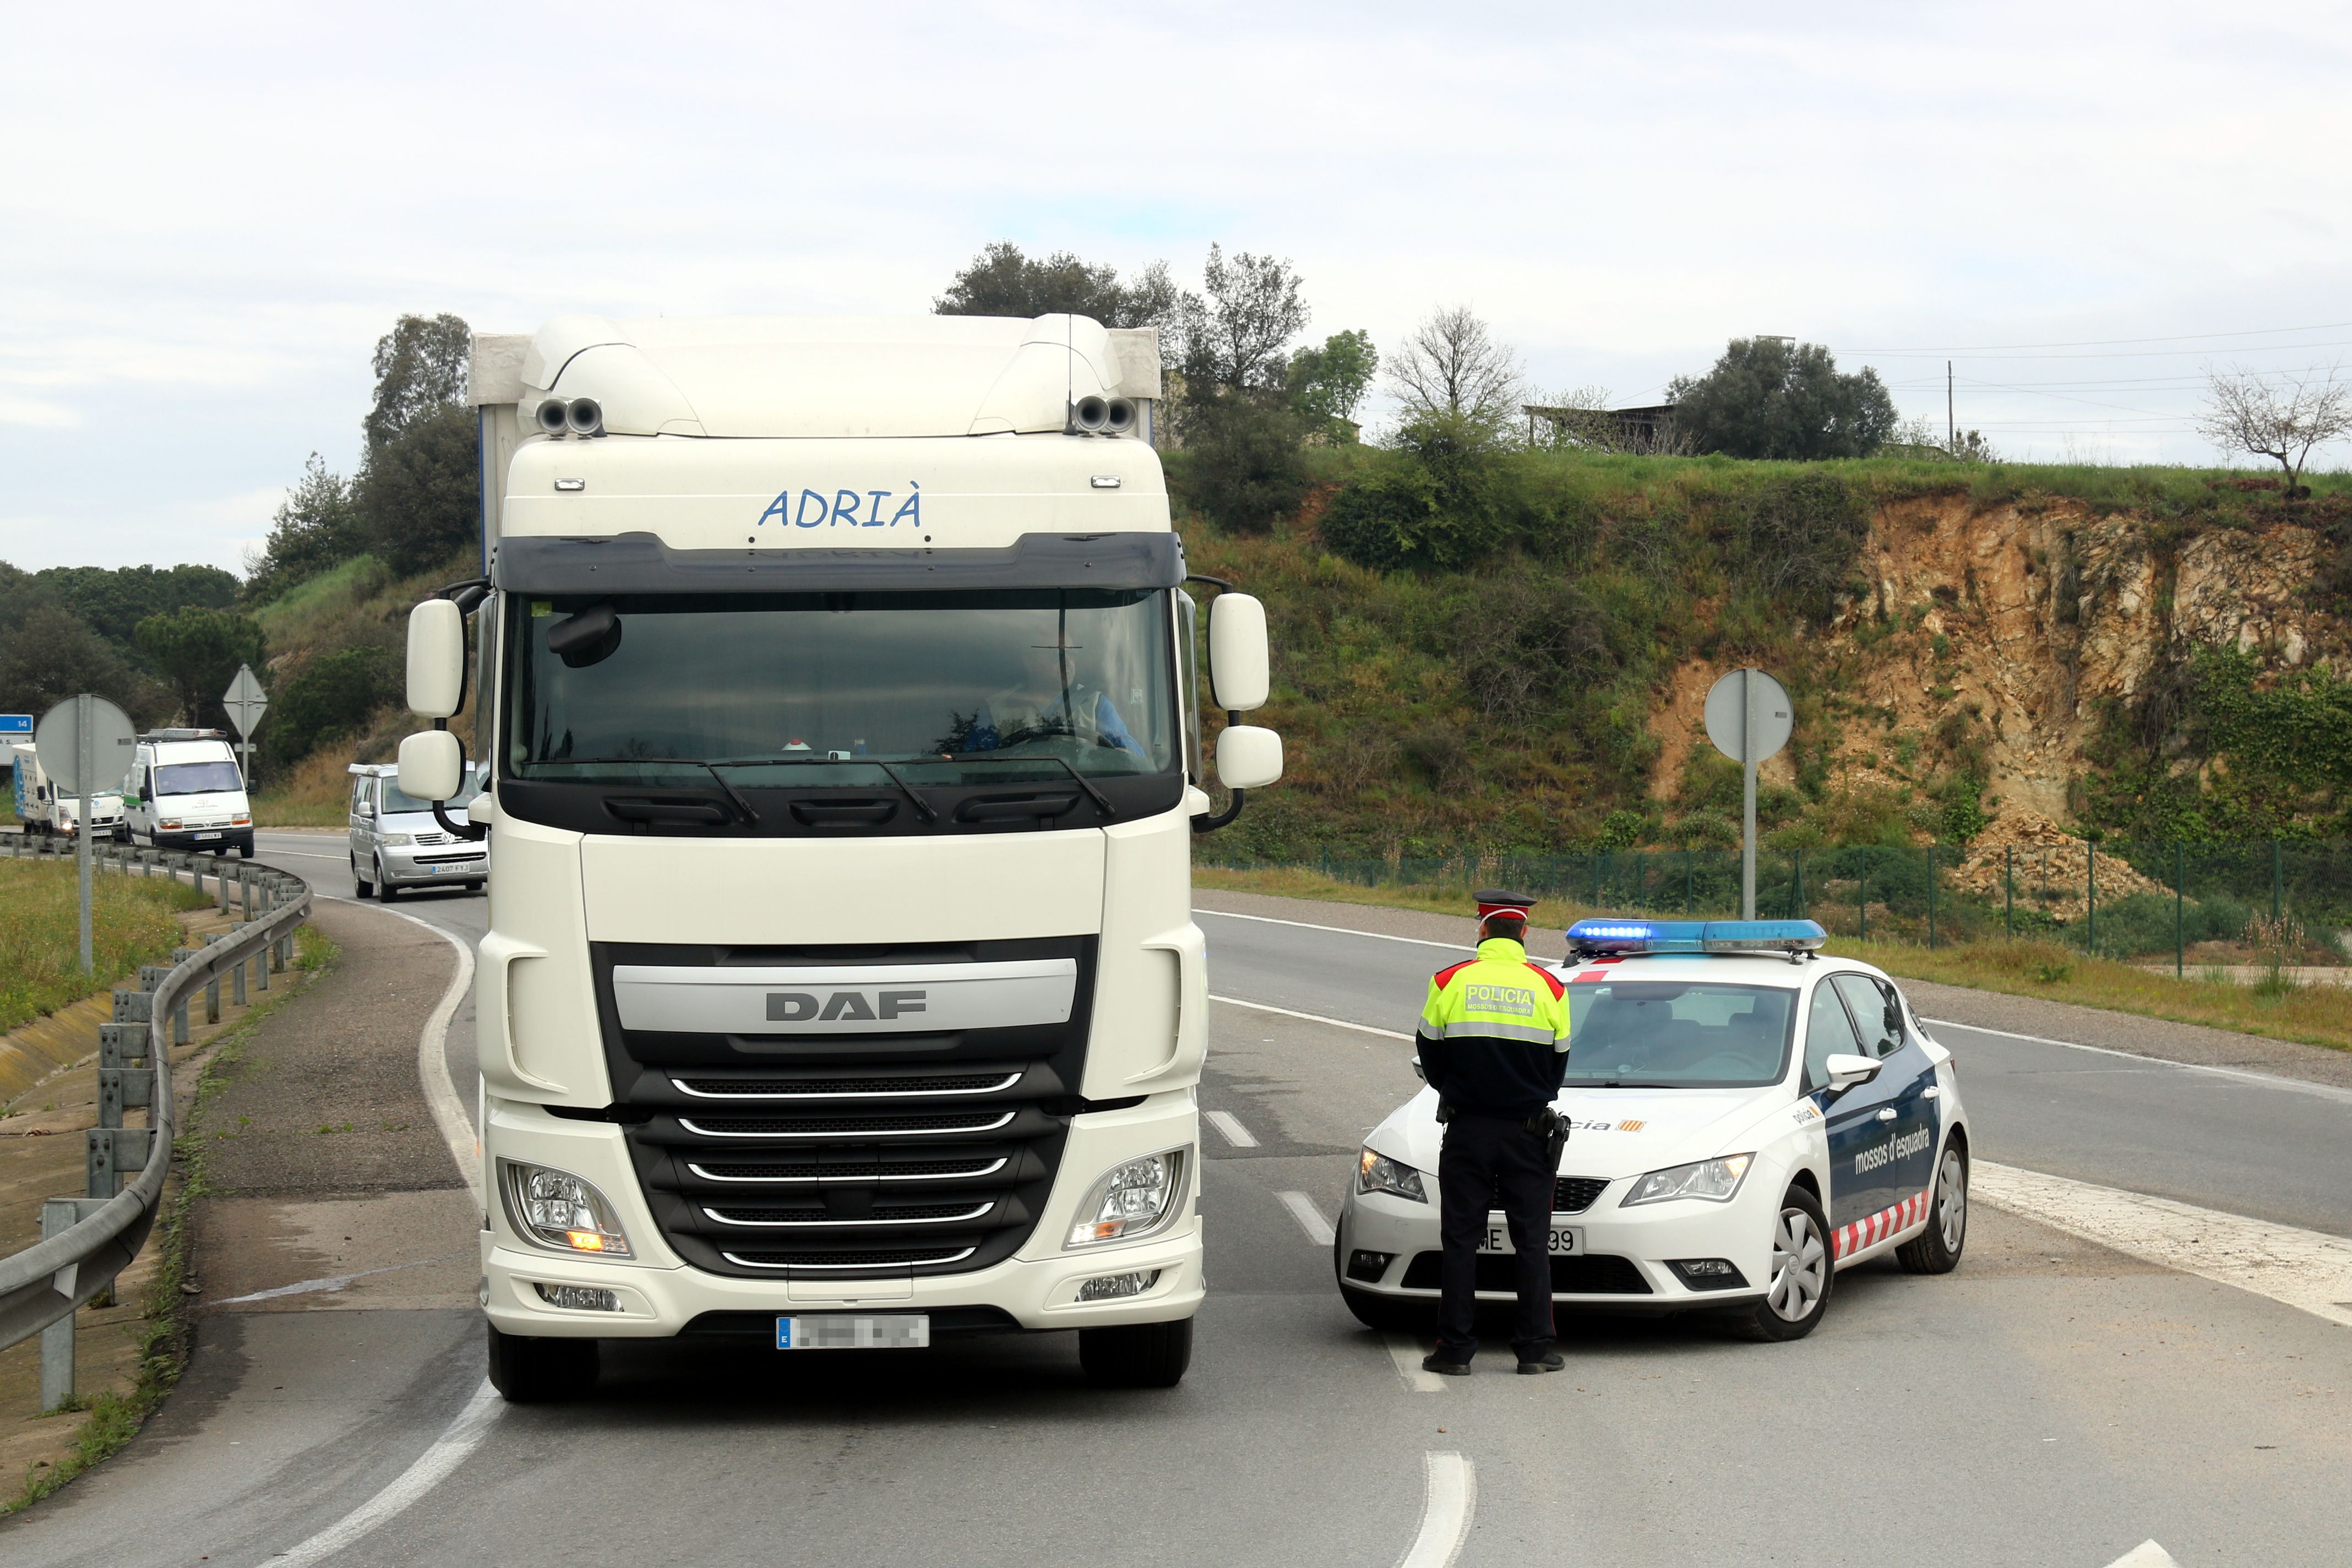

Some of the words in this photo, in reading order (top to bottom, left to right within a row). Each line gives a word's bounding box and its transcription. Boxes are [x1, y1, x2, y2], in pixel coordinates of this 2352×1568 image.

[758, 480, 920, 528] ADRIÀ
[766, 990, 926, 1021] DAF
[1468, 986, 1532, 1005] POLICIA
[1855, 1144, 1887, 1175] mossos
[1889, 1123, 1929, 1162] d'esquadra
